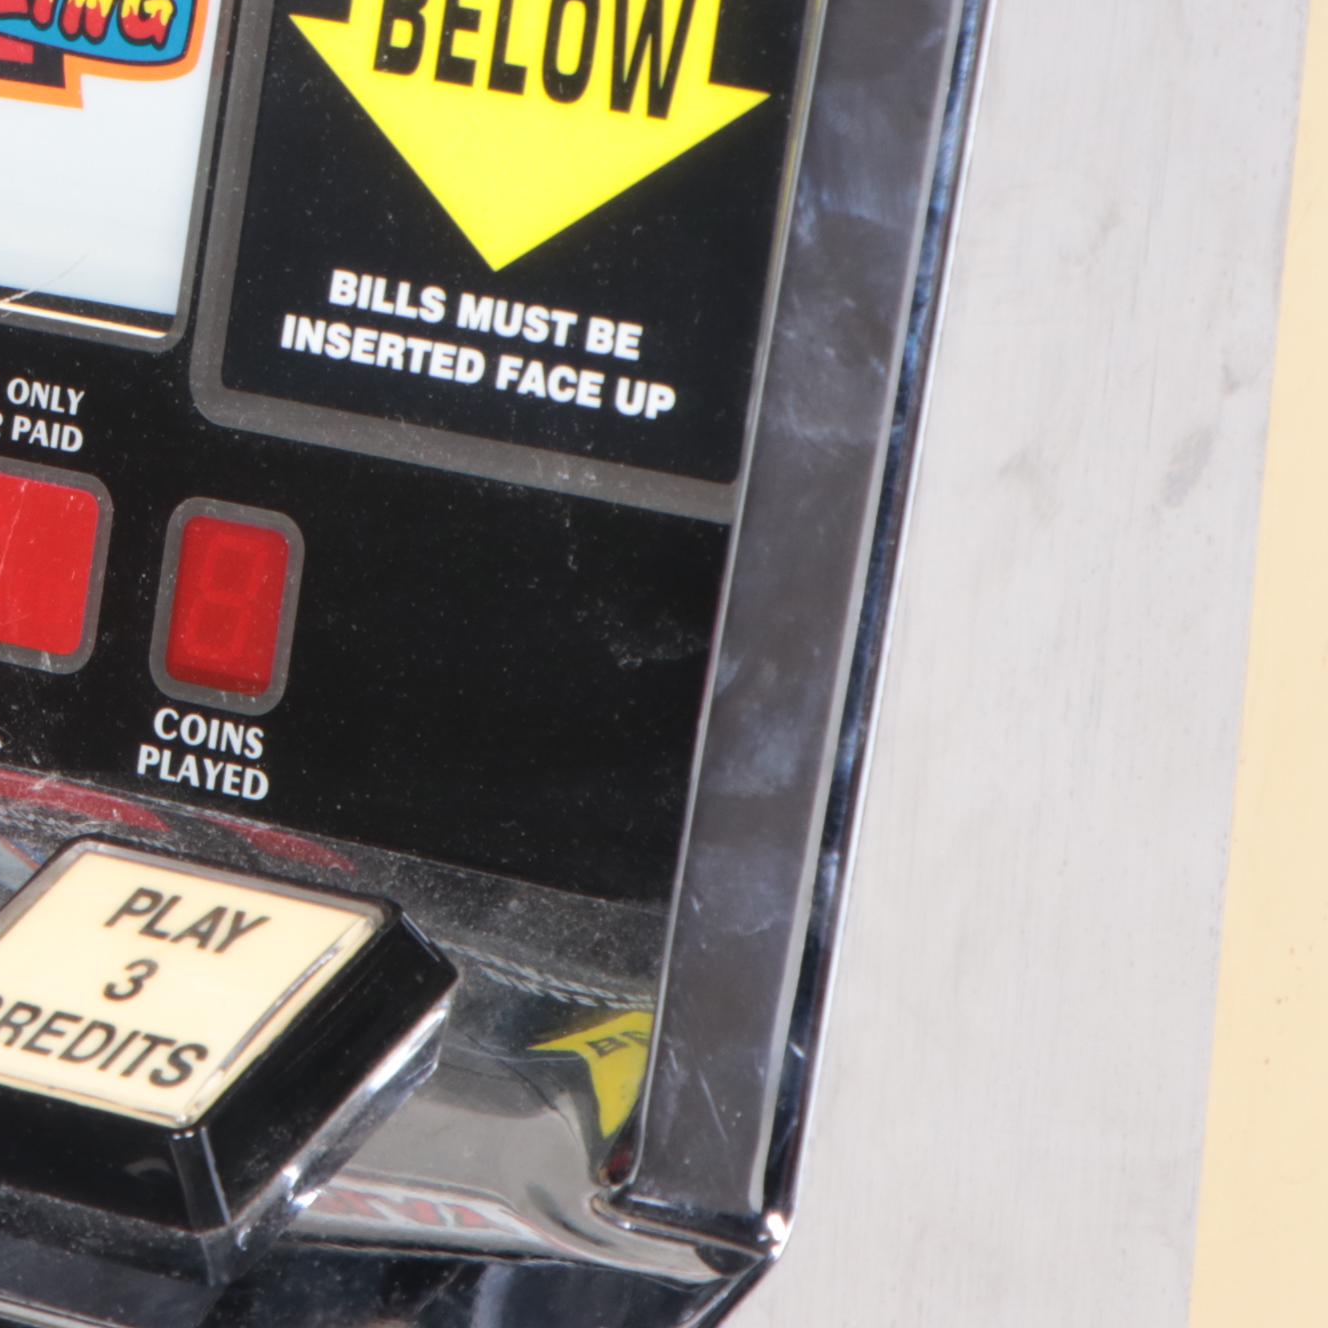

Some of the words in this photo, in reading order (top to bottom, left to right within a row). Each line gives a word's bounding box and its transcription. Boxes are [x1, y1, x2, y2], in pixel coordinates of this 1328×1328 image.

[329, 269, 447, 323] BILLS
[456, 294, 578, 348] MUST
[585, 318, 644, 361] BE
[280, 314, 487, 385] INSERTED
[495, 356, 603, 410] FACE
[615, 380, 677, 421] UP
[6, 375, 85, 418] ONLY
[11, 411, 84, 454] PAID
[153, 707, 265, 761] COINS
[137, 743, 270, 803] PLAYED
[105, 886, 272, 955] PLAY
[103, 959, 158, 1001] 3
